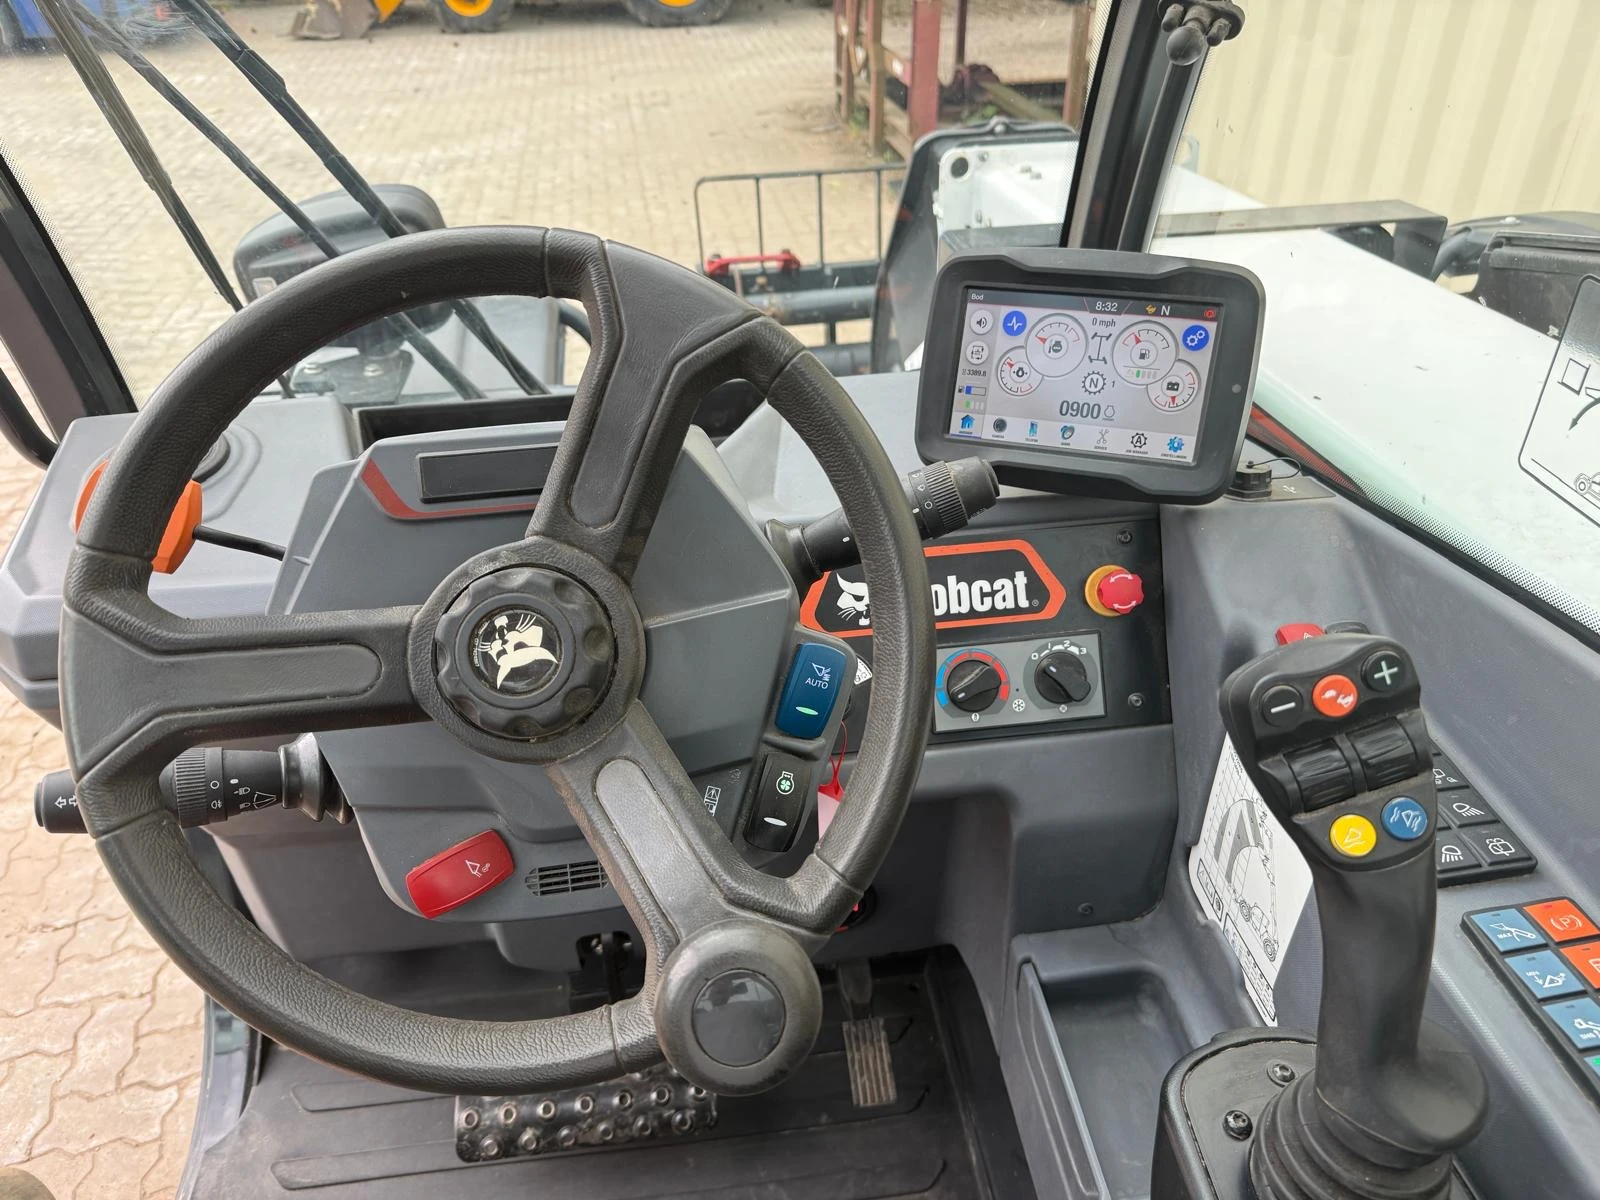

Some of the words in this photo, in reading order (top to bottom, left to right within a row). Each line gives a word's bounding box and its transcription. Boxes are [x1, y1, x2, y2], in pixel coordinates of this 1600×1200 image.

[1095, 301, 1118, 312] 8:32
[1160, 305, 1171, 316] N
[1092, 317, 1098, 326] 0
[1099, 319, 1116, 328] mph
[1089, 377, 1099, 389] N
[1060, 400, 1101, 419] 0900
[931, 570, 1030, 616] obcat
[1063, 639, 1071, 648] 2
[1080, 647, 1087, 655] 3
[805, 676, 829, 690] AUTO
